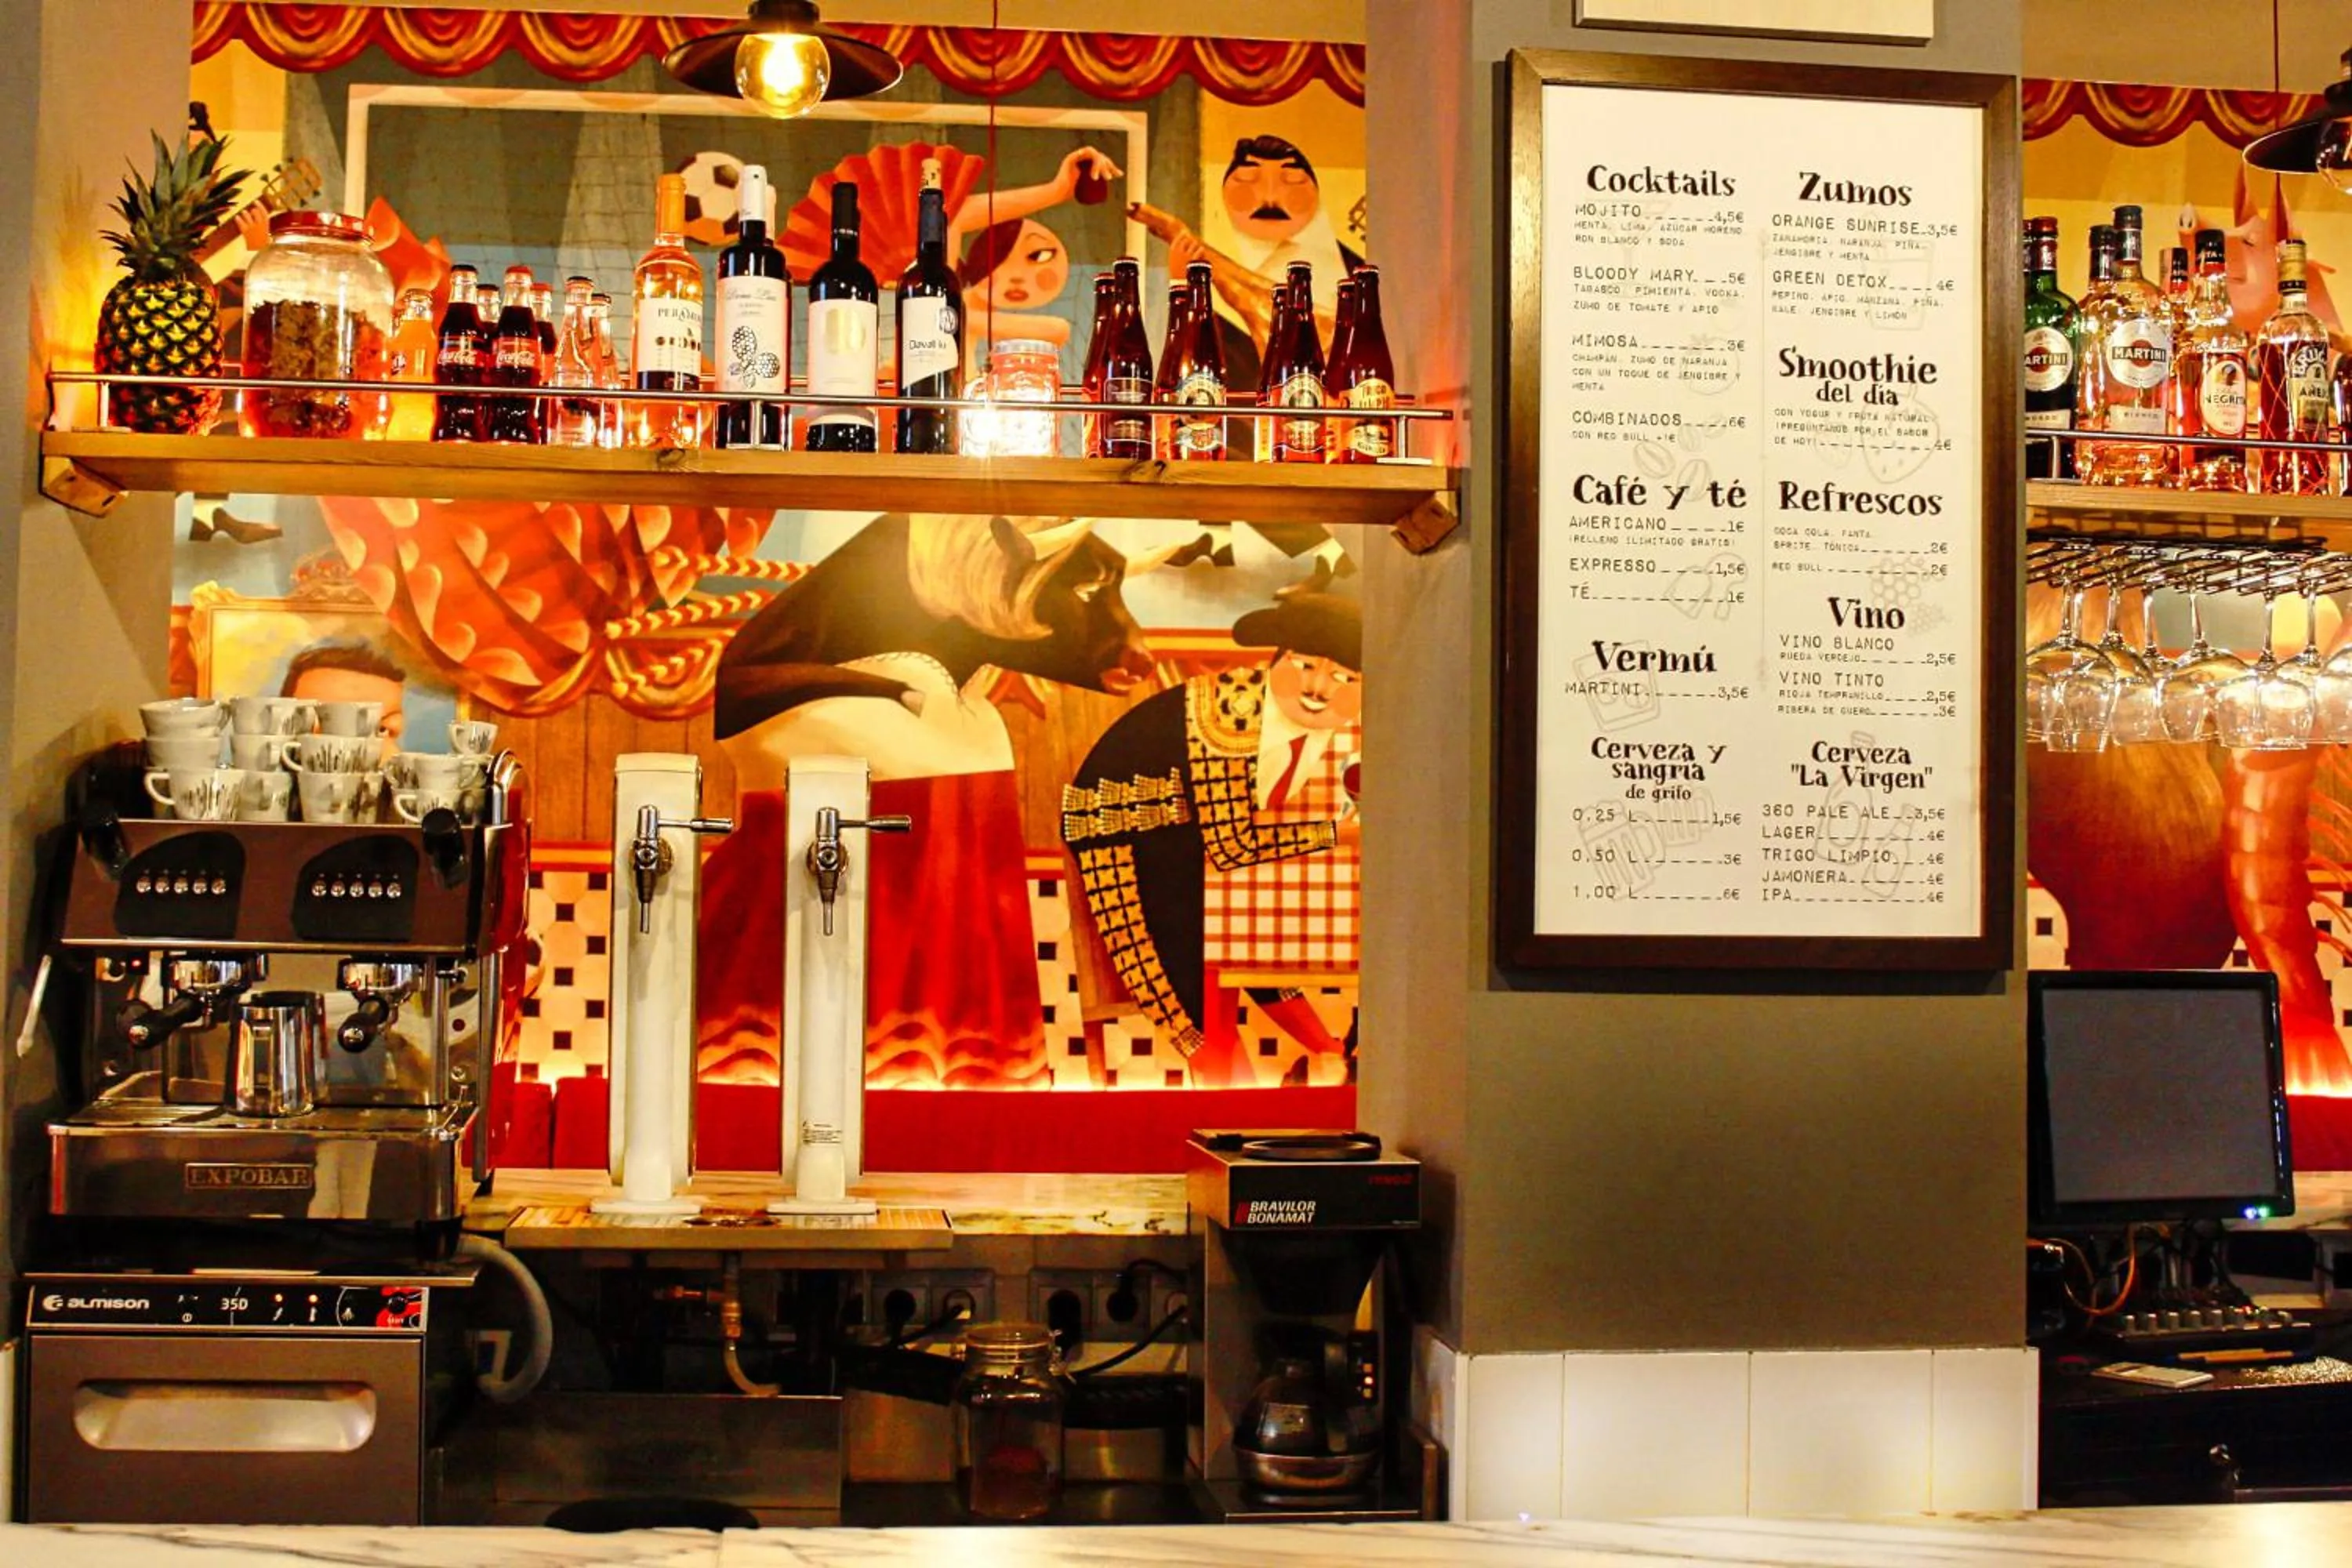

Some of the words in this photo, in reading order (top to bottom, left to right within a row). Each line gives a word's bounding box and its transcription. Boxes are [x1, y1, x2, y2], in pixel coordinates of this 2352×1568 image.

[1587, 164, 1736, 196] Cocktails
[1798, 172, 1912, 206] Zumos
[1575, 203, 1641, 217] MOJITO
[1714, 212, 1744, 224] 4,5€
[1772, 214, 1835, 230] ORANGE
[1847, 218, 1920, 234] SUNRISE
[1927, 224, 1958, 238] 3,5€
[1600, 236, 1639, 245] BLANCO
[1840, 252, 1869, 261] MENTA
[1573, 267, 1639, 280] BLOODY
[1650, 269, 1693, 281] MARY
[1728, 273, 1745, 285] 5€
[1773, 270, 1824, 285] GREEN
[1836, 274, 1887, 289] DETOX
[1936, 280, 1955, 291] 4€
[1573, 301, 1599, 310] ZUMO
[1608, 303, 1621, 311] DE
[1630, 303, 1669, 313] TOMATE
[1693, 305, 1719, 314] APIO
[1572, 334, 1639, 347] MIMOSA
[1726, 340, 1745, 351] 3€
[1682, 358, 1727, 366] NARANJA
[2025, 354, 2066, 365] ARTINI
[2114, 347, 2166, 361] MARTINI
[1778, 344, 1937, 383] Smoothie
[1572, 368, 1592, 376] CON
[1619, 369, 1650, 378] TOQUE
[1572, 383, 1604, 391] MENTA
[1816, 380, 1853, 402] del
[1864, 383, 1899, 405] día
[1572, 410, 1682, 426] COMBINADOS
[1729, 416, 1746, 428] 6€
[1800, 409, 1829, 418] YOGUR
[1849, 412, 1878, 421] FRUTA
[1572, 430, 1591, 440] CON
[1598, 431, 1617, 440] RED
[1623, 432, 1648, 441] BULL
[1854, 426, 1871, 434] POR
[1896, 428, 1929, 437] SABOR
[1934, 439, 1951, 451] 4€
[1573, 474, 1646, 505] Café
[1663, 485, 1690, 510] y
[1707, 479, 1747, 508] té
[1778, 481, 1943, 516] Refrescos
[1569, 515, 1667, 530] AMERICANO
[1728, 521, 1744, 532] 1€
[1773, 526, 1798, 535] COCA
[1931, 542, 1948, 554] 2€
[1570, 557, 1657, 573] EXPRESSO
[1715, 563, 1745, 576] 1,5€
[1772, 561, 1791, 572] RED
[1798, 563, 1821, 572] BULL
[1931, 564, 1948, 576] 2€
[1570, 582, 1590, 600] TÉ
[1728, 592, 1745, 603] 1€
[1828, 597, 1905, 629] Vino
[1780, 634, 1822, 648] VINO
[1834, 637, 1894, 651] BLANCO
[1592, 640, 1717, 673] Vermú
[1780, 652, 1811, 660] RUEDA
[1819, 653, 1860, 662] VERDEJO
[1926, 652, 1957, 666] 2,5€
[1780, 670, 1821, 685] VINO
[1835, 672, 1884, 688] TINTO
[1565, 681, 1641, 696] MARTINI
[1718, 686, 1749, 700] 3,5€
[1779, 689, 1810, 698] RIOJA
[1926, 691, 1957, 704] 2,5€
[1777, 705, 1816, 714] RIBERA
[1939, 705, 1957, 717] 3€
[1591, 736, 1695, 762] Cerveza
[1708, 745, 1726, 764] y
[1812, 740, 1912, 765] Cerveza
[1791, 763, 1828, 787] "La
[1841, 764, 1933, 794] Virgen"
[1625, 784, 1645, 799] de
[1652, 786, 1692, 803] grifo
[1712, 813, 1741, 826] 1,5€
[1762, 804, 1794, 817] 360
[1806, 805, 1849, 818] PALE
[1860, 807, 1889, 819] ALE
[1915, 808, 1945, 822] 3,5€
[1762, 826, 1816, 840] LAGER
[1927, 830, 1945, 841] 4€
[1724, 854, 1741, 865] 3€
[1762, 848, 1816, 862] TRIGO
[1828, 849, 1890, 863] LIMPIO
[1927, 853, 1945, 864] 4€
[1762, 869, 1847, 884] JAMONERA
[1927, 873, 1945, 885] 4€
[1723, 888, 1740, 900] 6€
[1762, 888, 1792, 902] IPA
[1926, 891, 1944, 902] 4€
[191, 1168, 308, 1185] EXPOBAR
[1250, 1200, 1316, 1211] BRAVILOR
[1247, 1213, 1316, 1224] BONAMAT
[67, 1298, 150, 1309] almison
